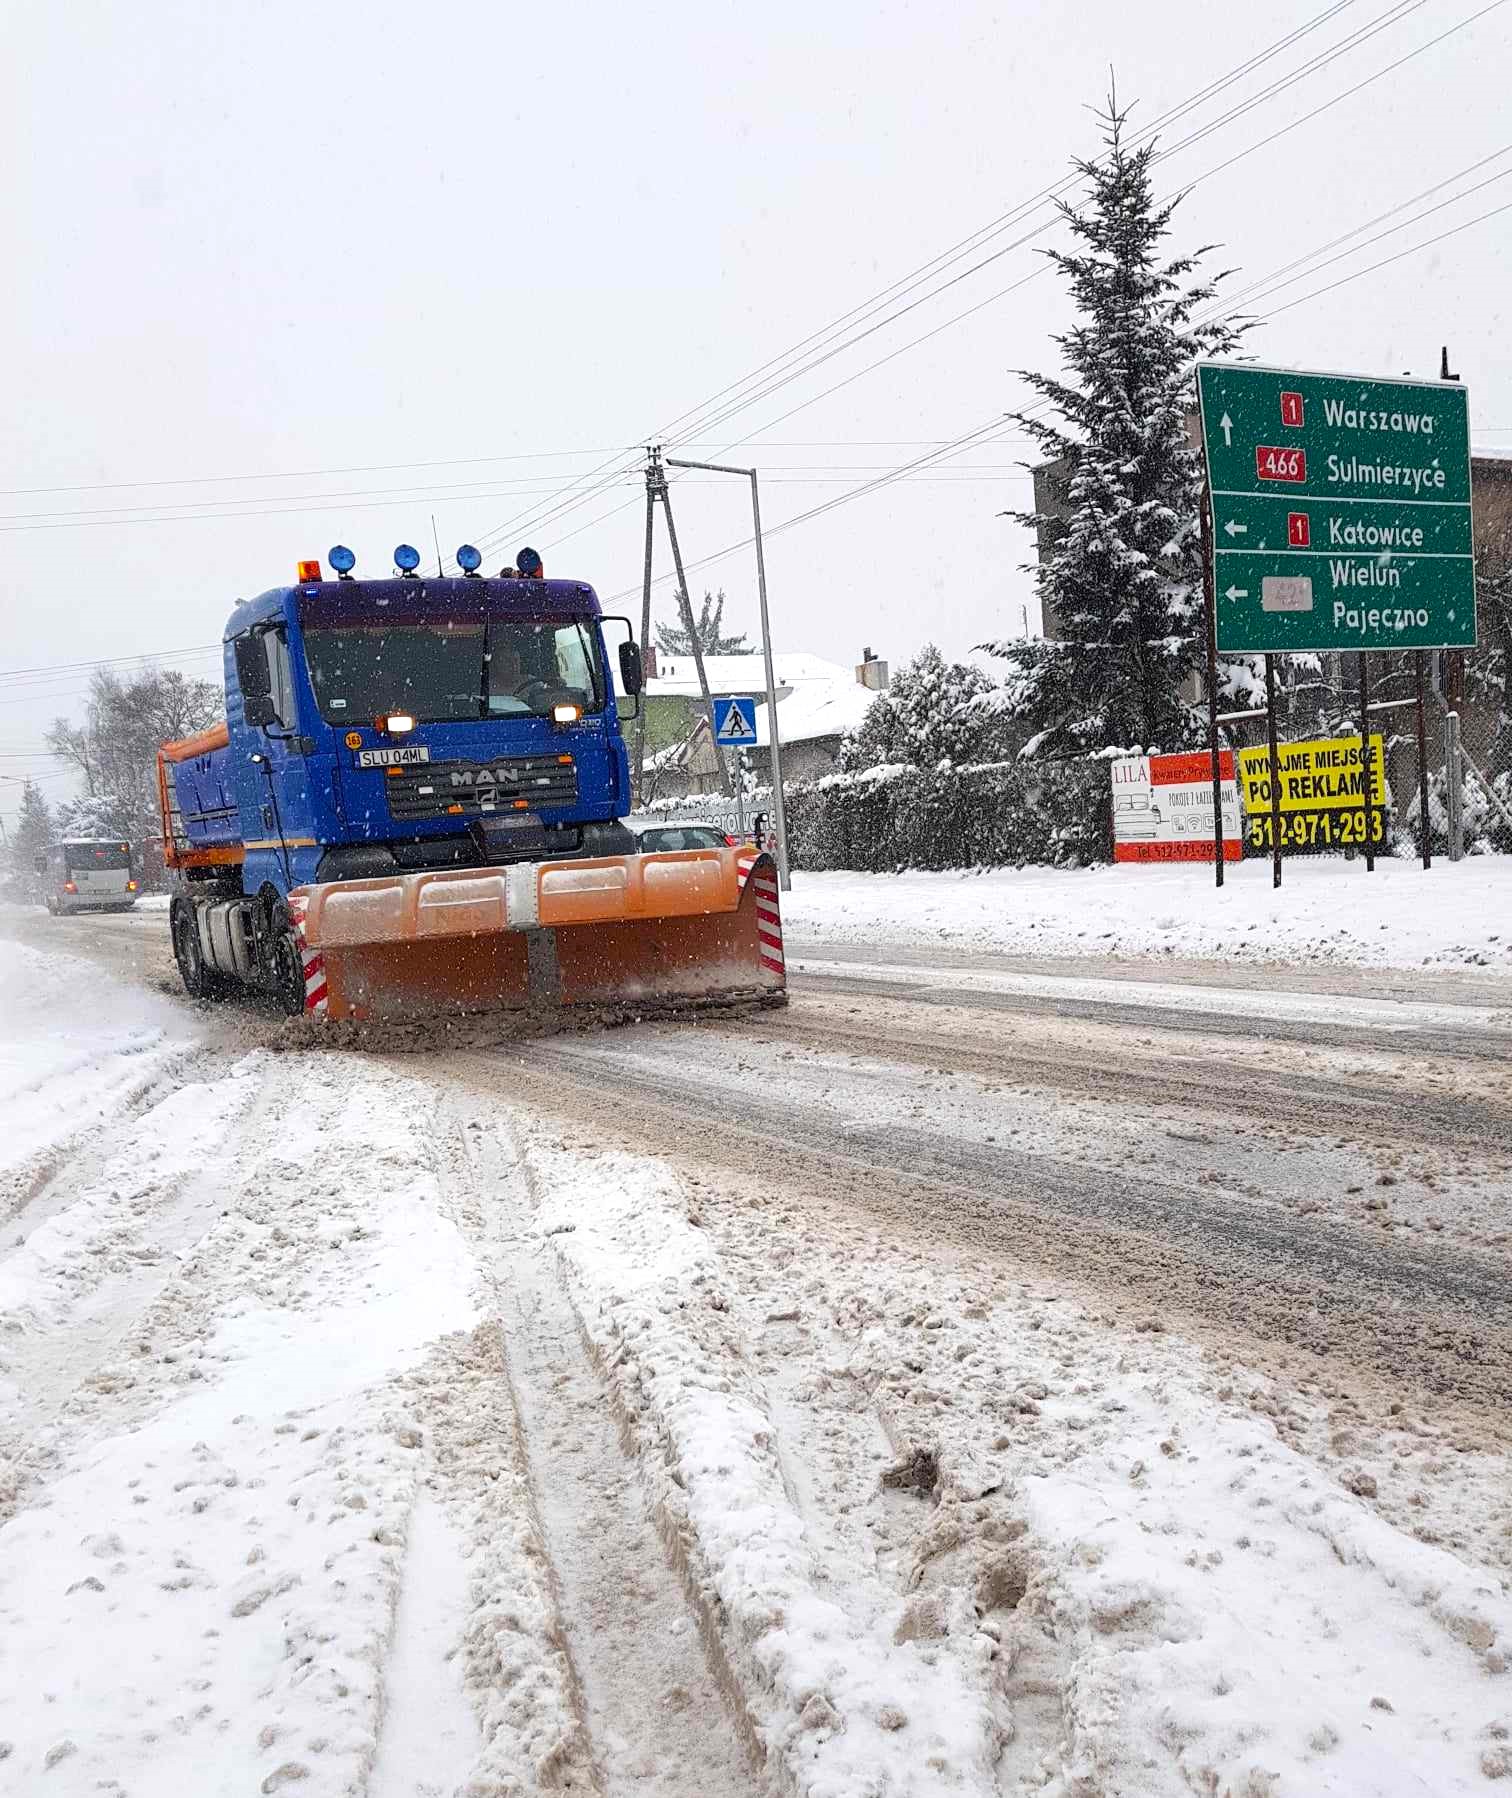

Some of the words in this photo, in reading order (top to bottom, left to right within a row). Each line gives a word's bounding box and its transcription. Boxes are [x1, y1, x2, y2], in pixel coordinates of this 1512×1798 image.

[1289, 399, 1297, 420] 1
[1323, 398, 1434, 434] Warszawa
[1265, 453, 1298, 476] 466
[1327, 454, 1446, 494] Sulmierzyce
[1296, 520, 1304, 540] 1
[1329, 517, 1424, 547] Katowice
[1333, 601, 1429, 635] Pajęczno
[362, 751, 389, 766] SLU
[393, 748, 428, 763] 04ML
[451, 768, 519, 786] MAN
[1114, 764, 1148, 784] LILA
[1155, 843, 1222, 857] 512-971-29
